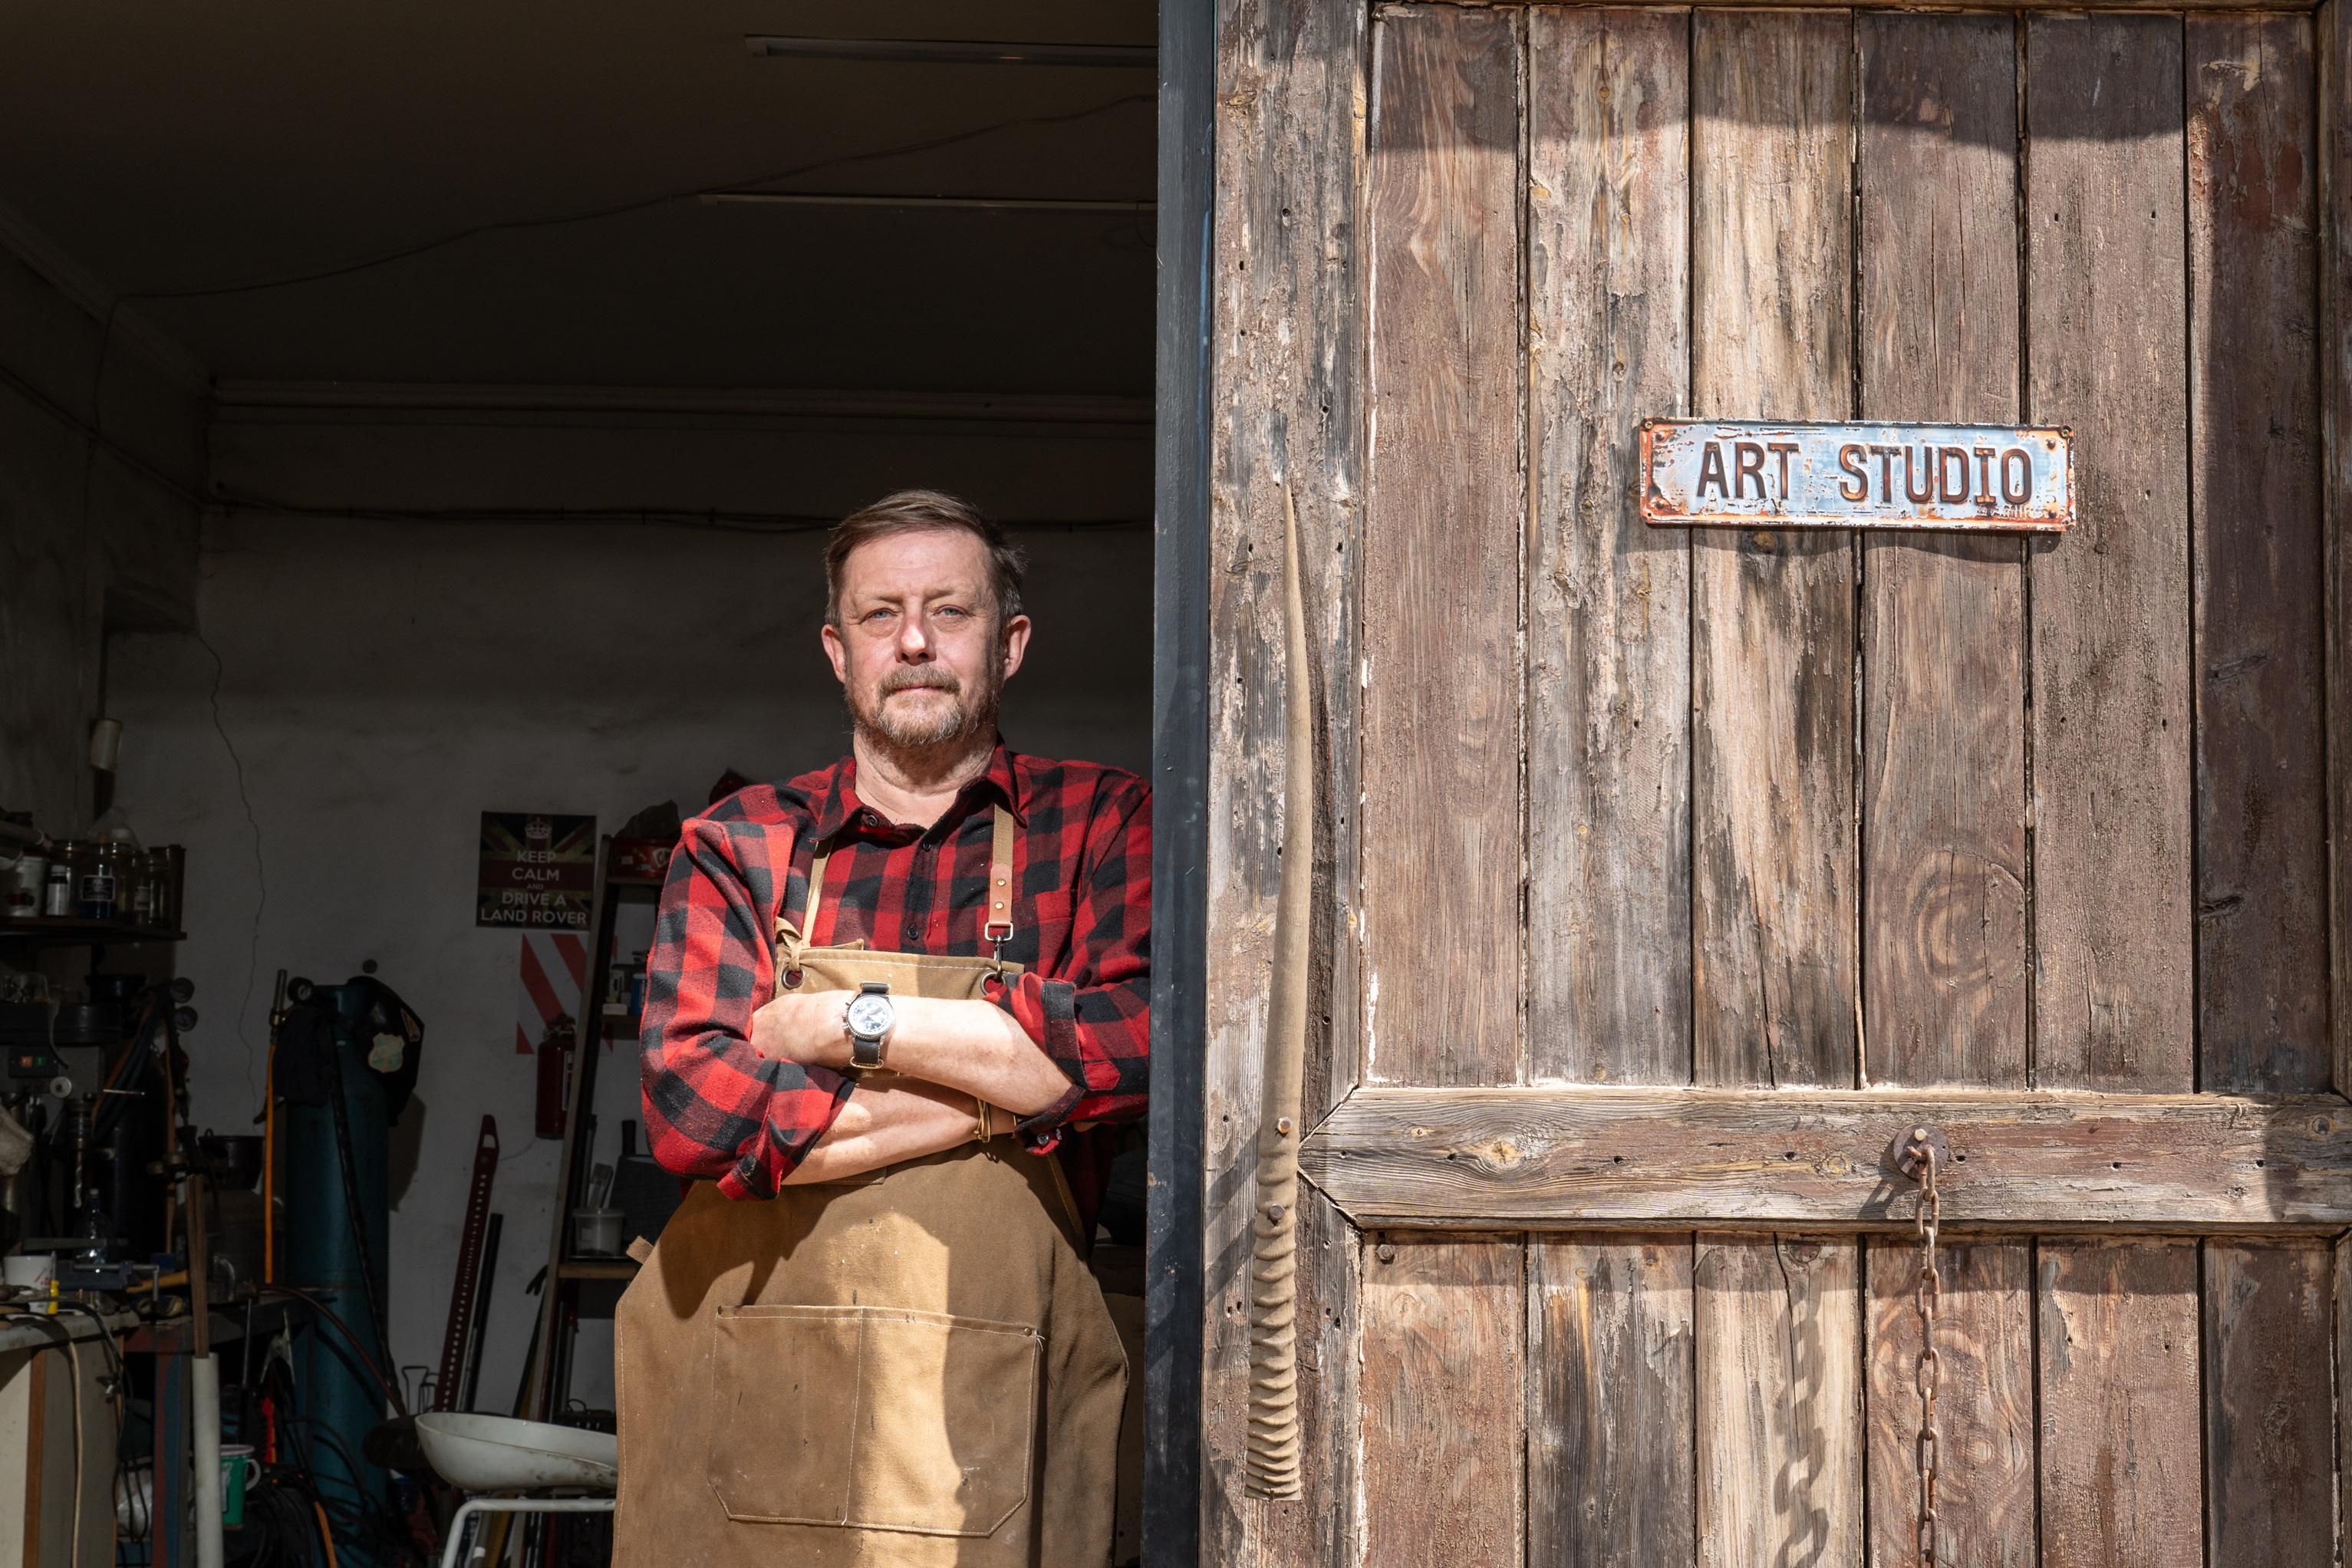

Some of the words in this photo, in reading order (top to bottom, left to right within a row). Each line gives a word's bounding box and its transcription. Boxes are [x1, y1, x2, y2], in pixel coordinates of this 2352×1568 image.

[1697, 441, 1800, 500] ART
[1840, 443, 2032, 505] STUDIO
[516, 849, 558, 864] KEEP
[512, 868, 560, 882] CALM
[502, 891, 550, 906] DRIVE
[555, 896, 567, 907] A
[481, 908, 528, 922] LAND
[532, 911, 587, 924] ROVER
